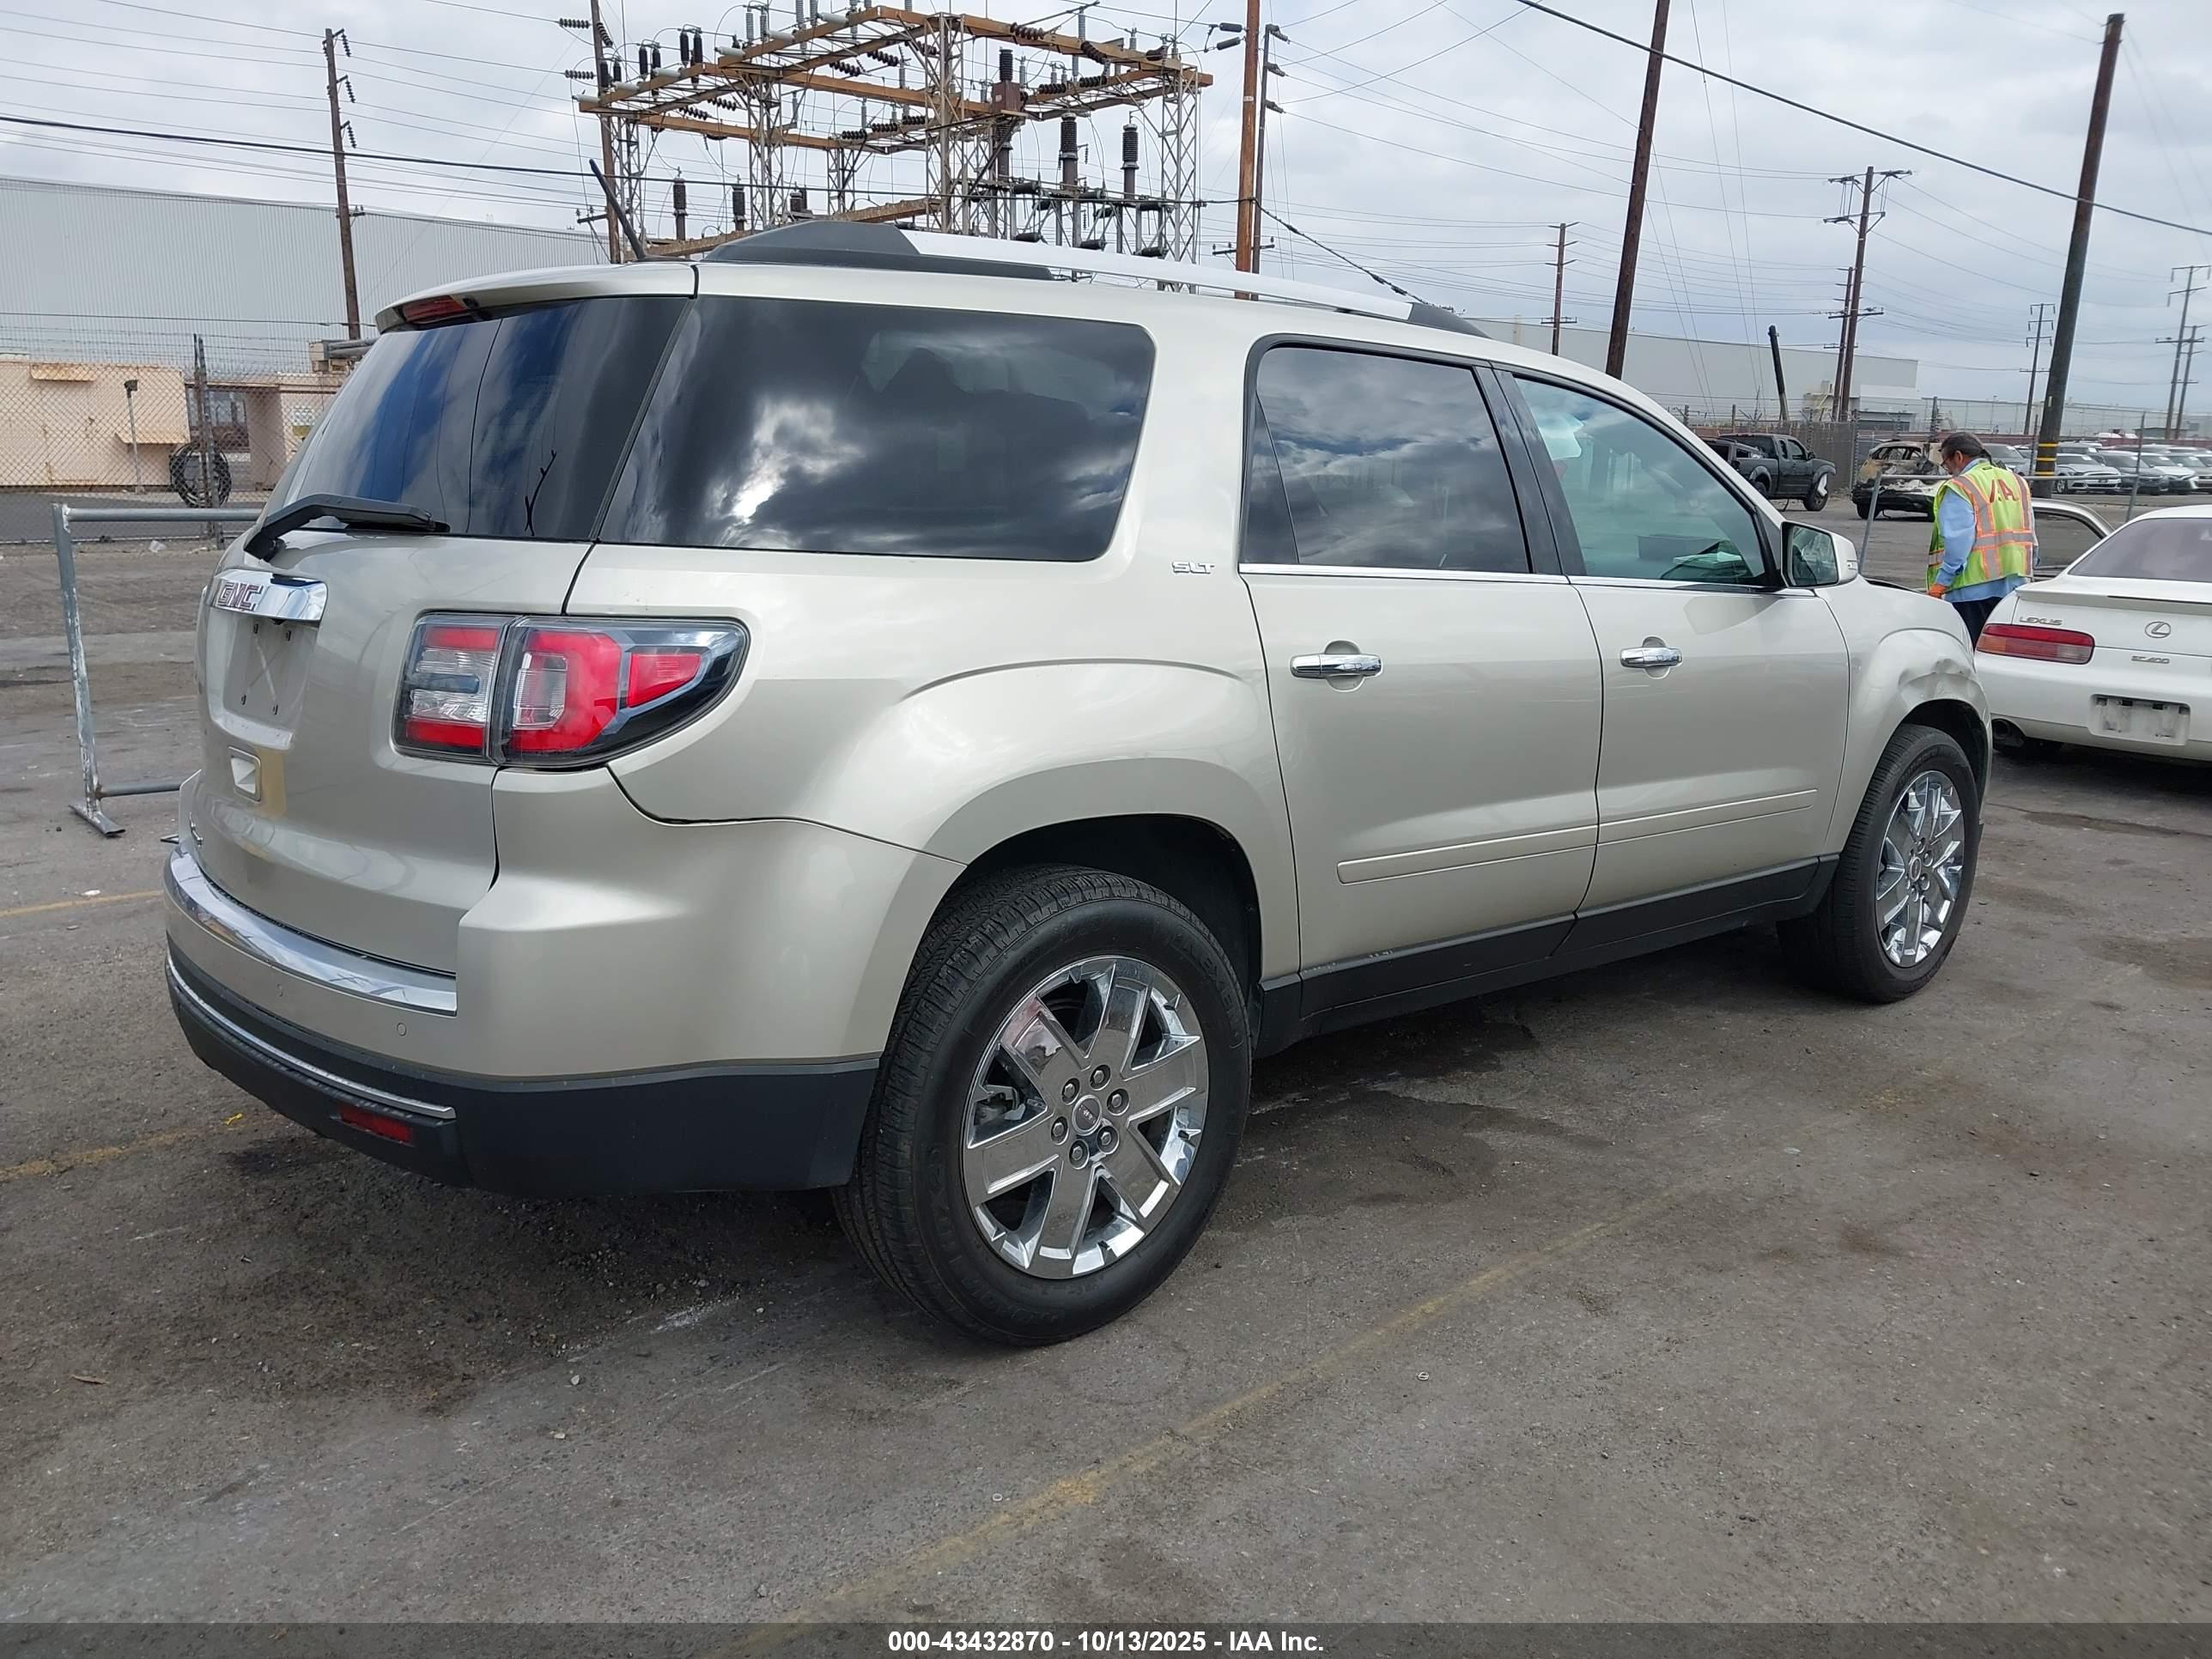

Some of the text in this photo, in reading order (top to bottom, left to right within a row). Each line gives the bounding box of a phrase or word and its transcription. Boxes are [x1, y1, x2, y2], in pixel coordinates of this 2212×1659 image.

[1171, 561, 1216, 575] SLT
[217, 581, 264, 611] GMC
[2019, 616, 2063, 626] LEXUS
